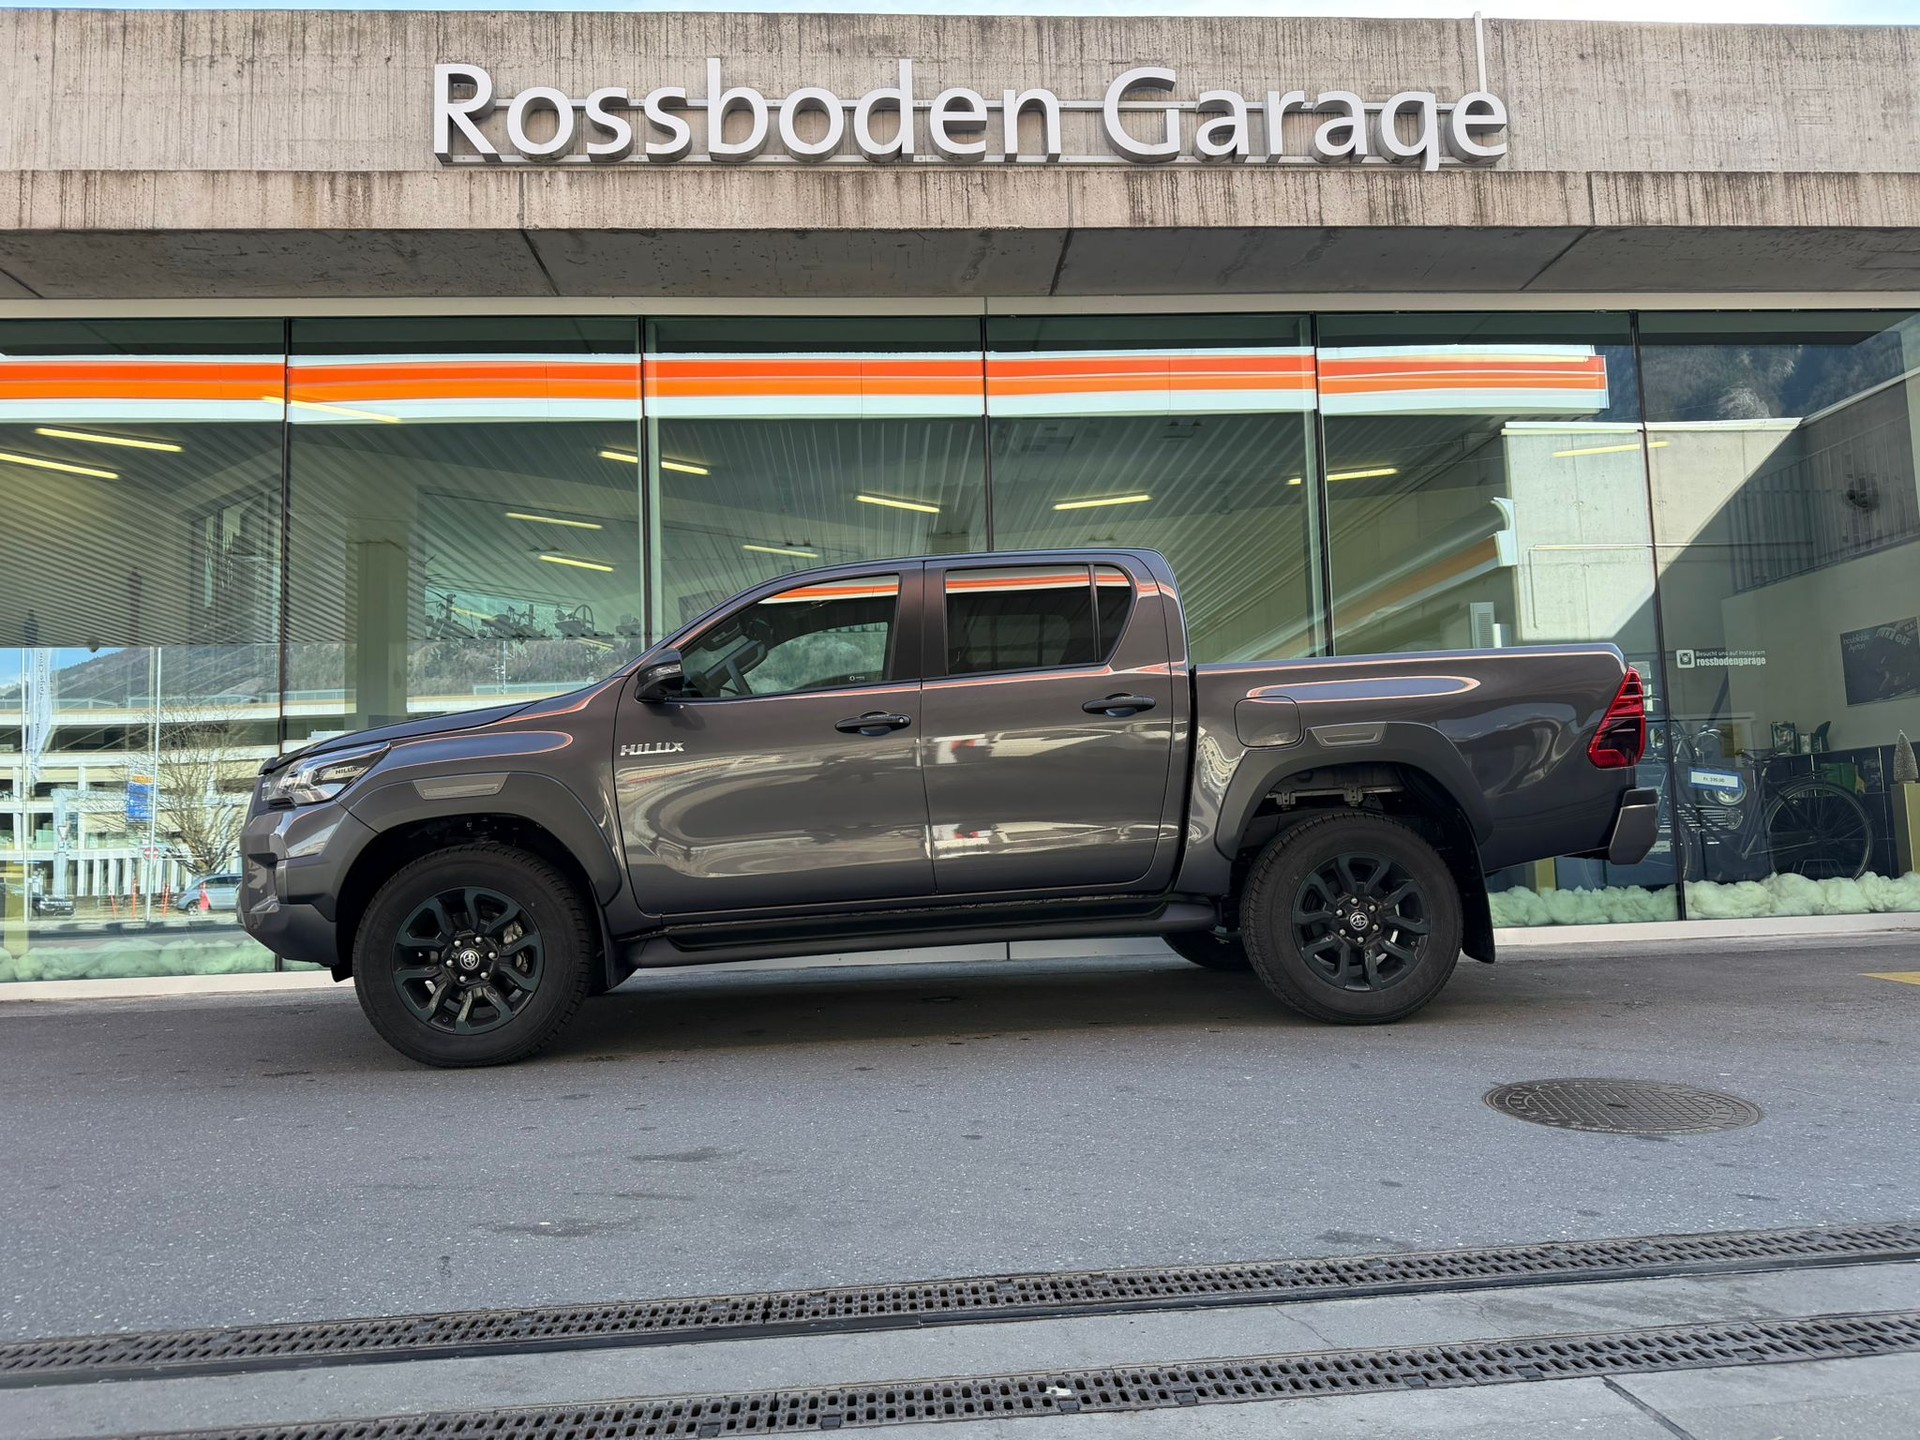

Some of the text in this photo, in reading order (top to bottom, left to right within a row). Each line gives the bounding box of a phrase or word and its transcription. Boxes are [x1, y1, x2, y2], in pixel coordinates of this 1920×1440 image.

[434, 58, 1508, 171] Rossboden Garage
[1696, 657, 1767, 667] rossbodengarage
[620, 742, 685, 757] HILUX
[335, 766, 358, 775] HILUX
